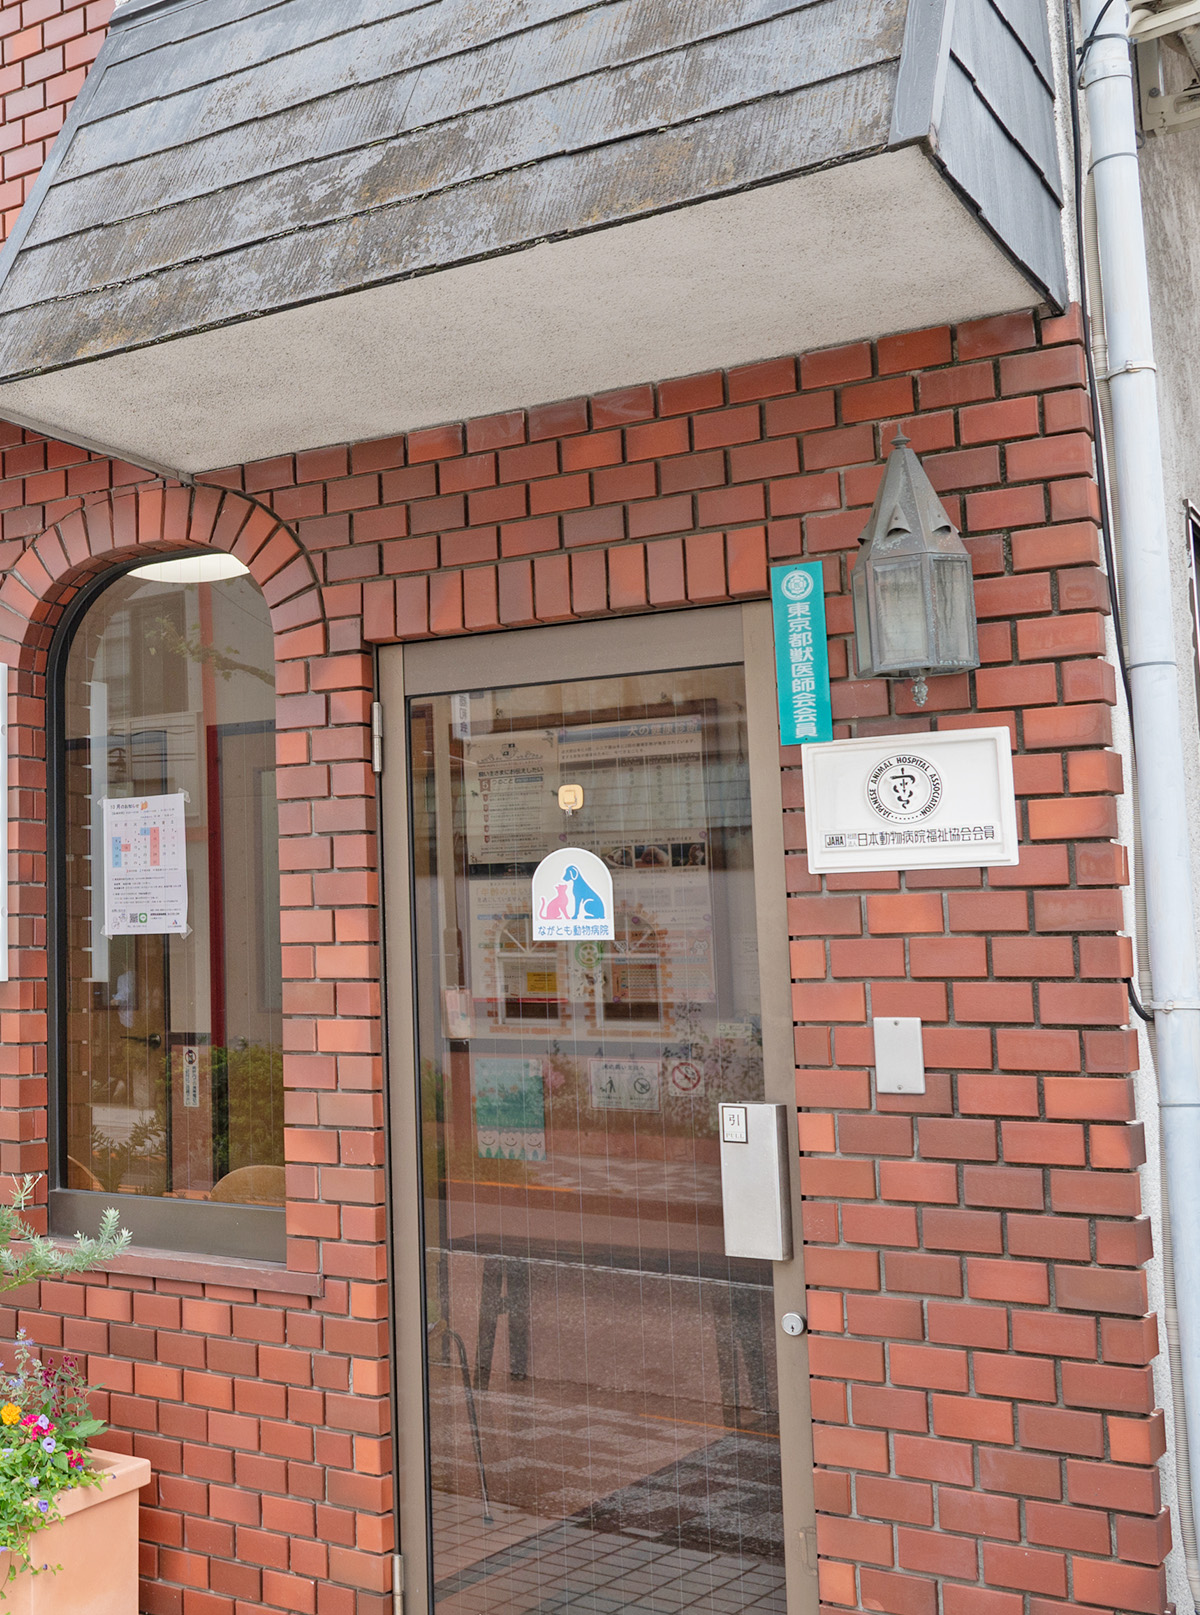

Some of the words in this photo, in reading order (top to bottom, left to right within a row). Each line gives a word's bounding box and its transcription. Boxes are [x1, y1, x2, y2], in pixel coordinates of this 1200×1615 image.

[786, 601, 818, 739] 東京都獣医師会会員
[870, 760, 893, 785] ANIMAL
[896, 756, 930, 772] HOSPITAL
[869, 788, 892, 818] JAPANESE
[920, 773, 941, 816] ASSOCIATION
[858, 826, 994, 847] 日本動物病院福祉協会会員
[537, 924, 609, 937] ながとも動物病院
[728, 1114, 740, 1126] 引
